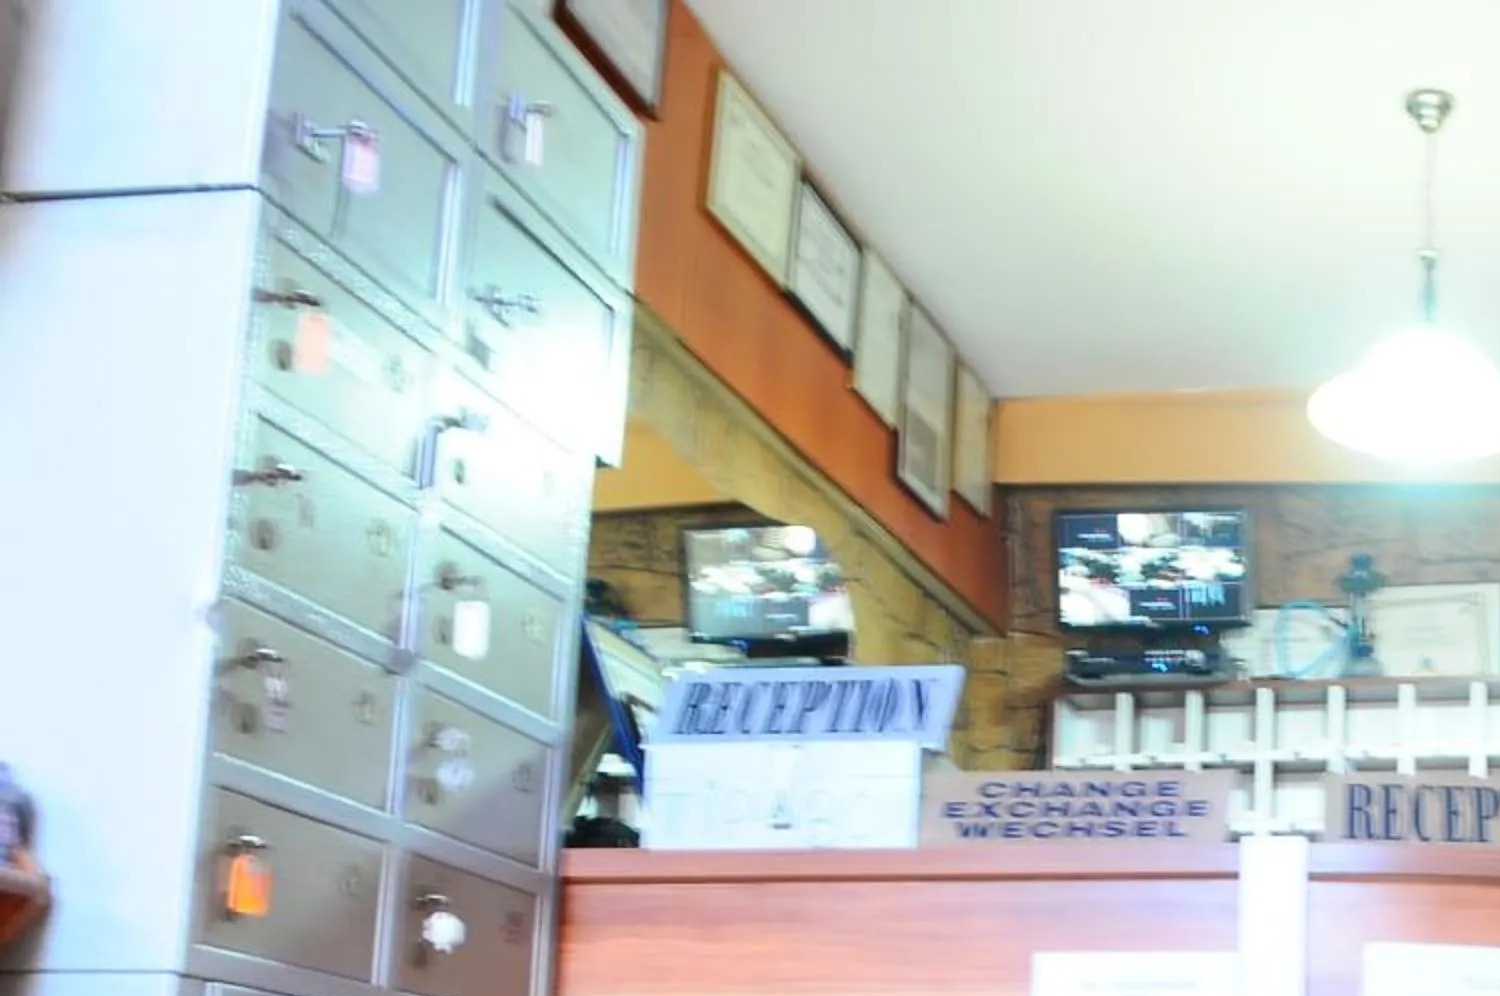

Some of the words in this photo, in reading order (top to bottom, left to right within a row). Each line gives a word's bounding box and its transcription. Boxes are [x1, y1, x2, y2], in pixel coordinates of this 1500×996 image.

[671, 677, 939, 734] RECEPTION
[979, 781, 1181, 798] CHANGE
[945, 800, 1208, 817] EXCHANGE
[956, 820, 1187, 838] WECHSEL
